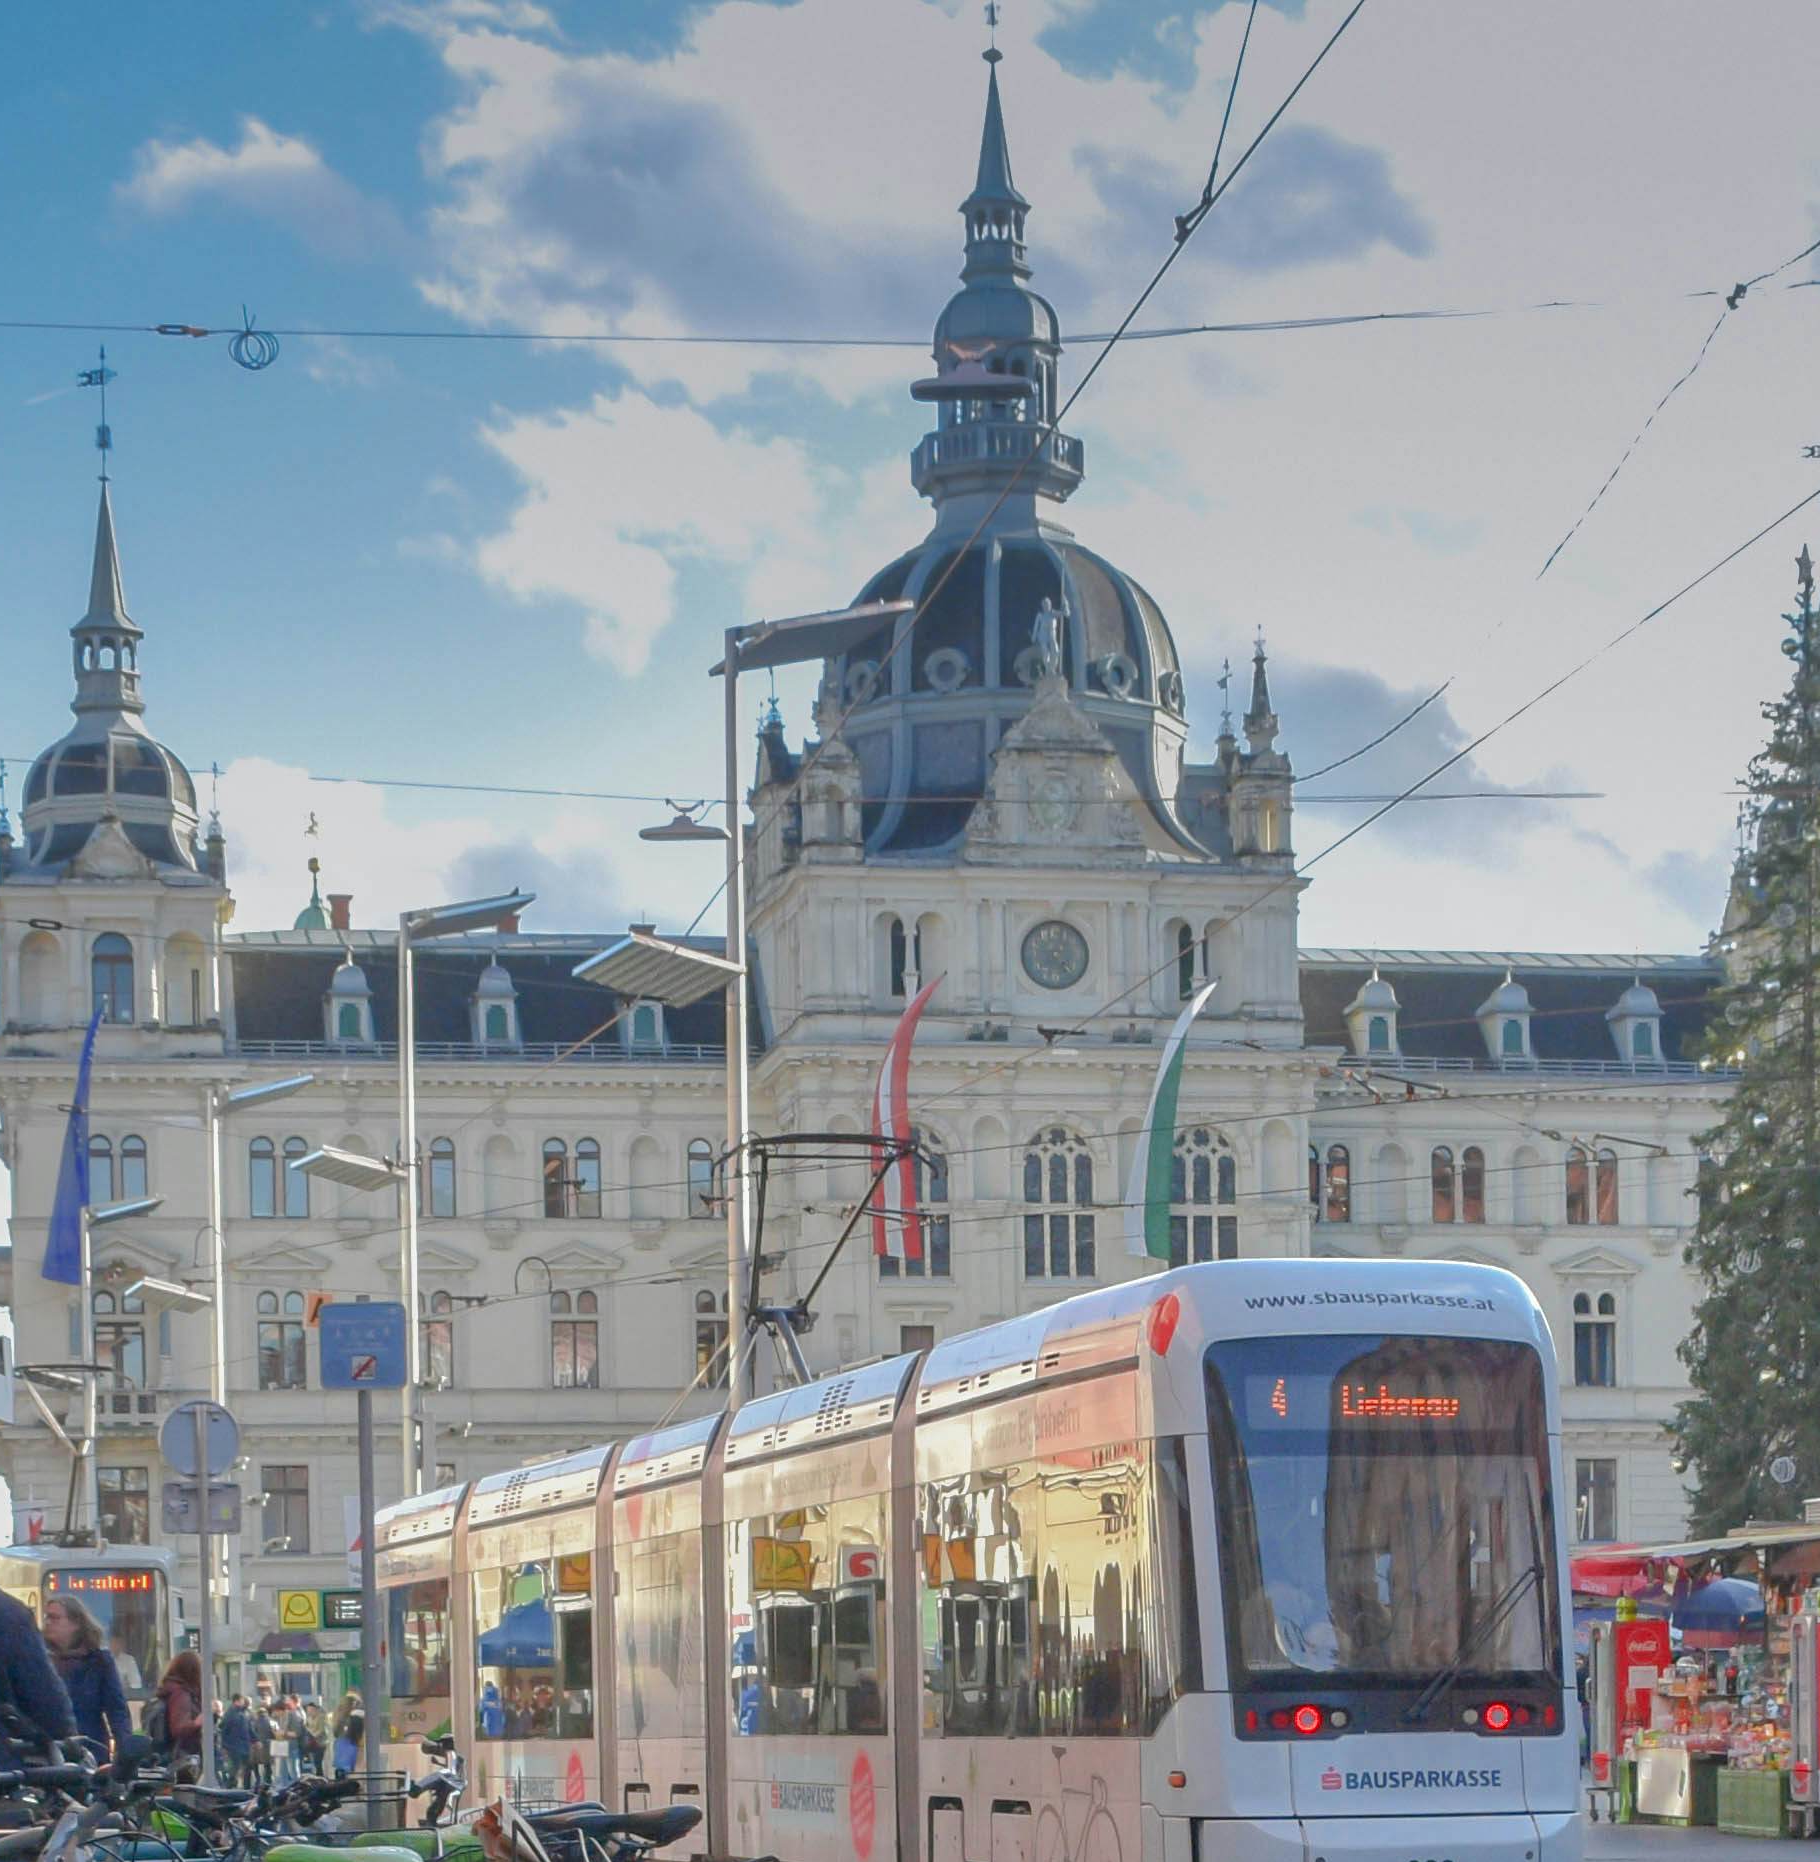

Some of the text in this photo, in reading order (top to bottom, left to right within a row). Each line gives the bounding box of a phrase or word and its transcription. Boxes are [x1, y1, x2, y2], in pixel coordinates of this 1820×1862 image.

[1244, 1291, 1495, 1312] www.sbausparkasse.at
[1270, 1378, 1461, 1416] 4 Liebenau
[1345, 1769, 1501, 1790] BAUSPARKASSE
